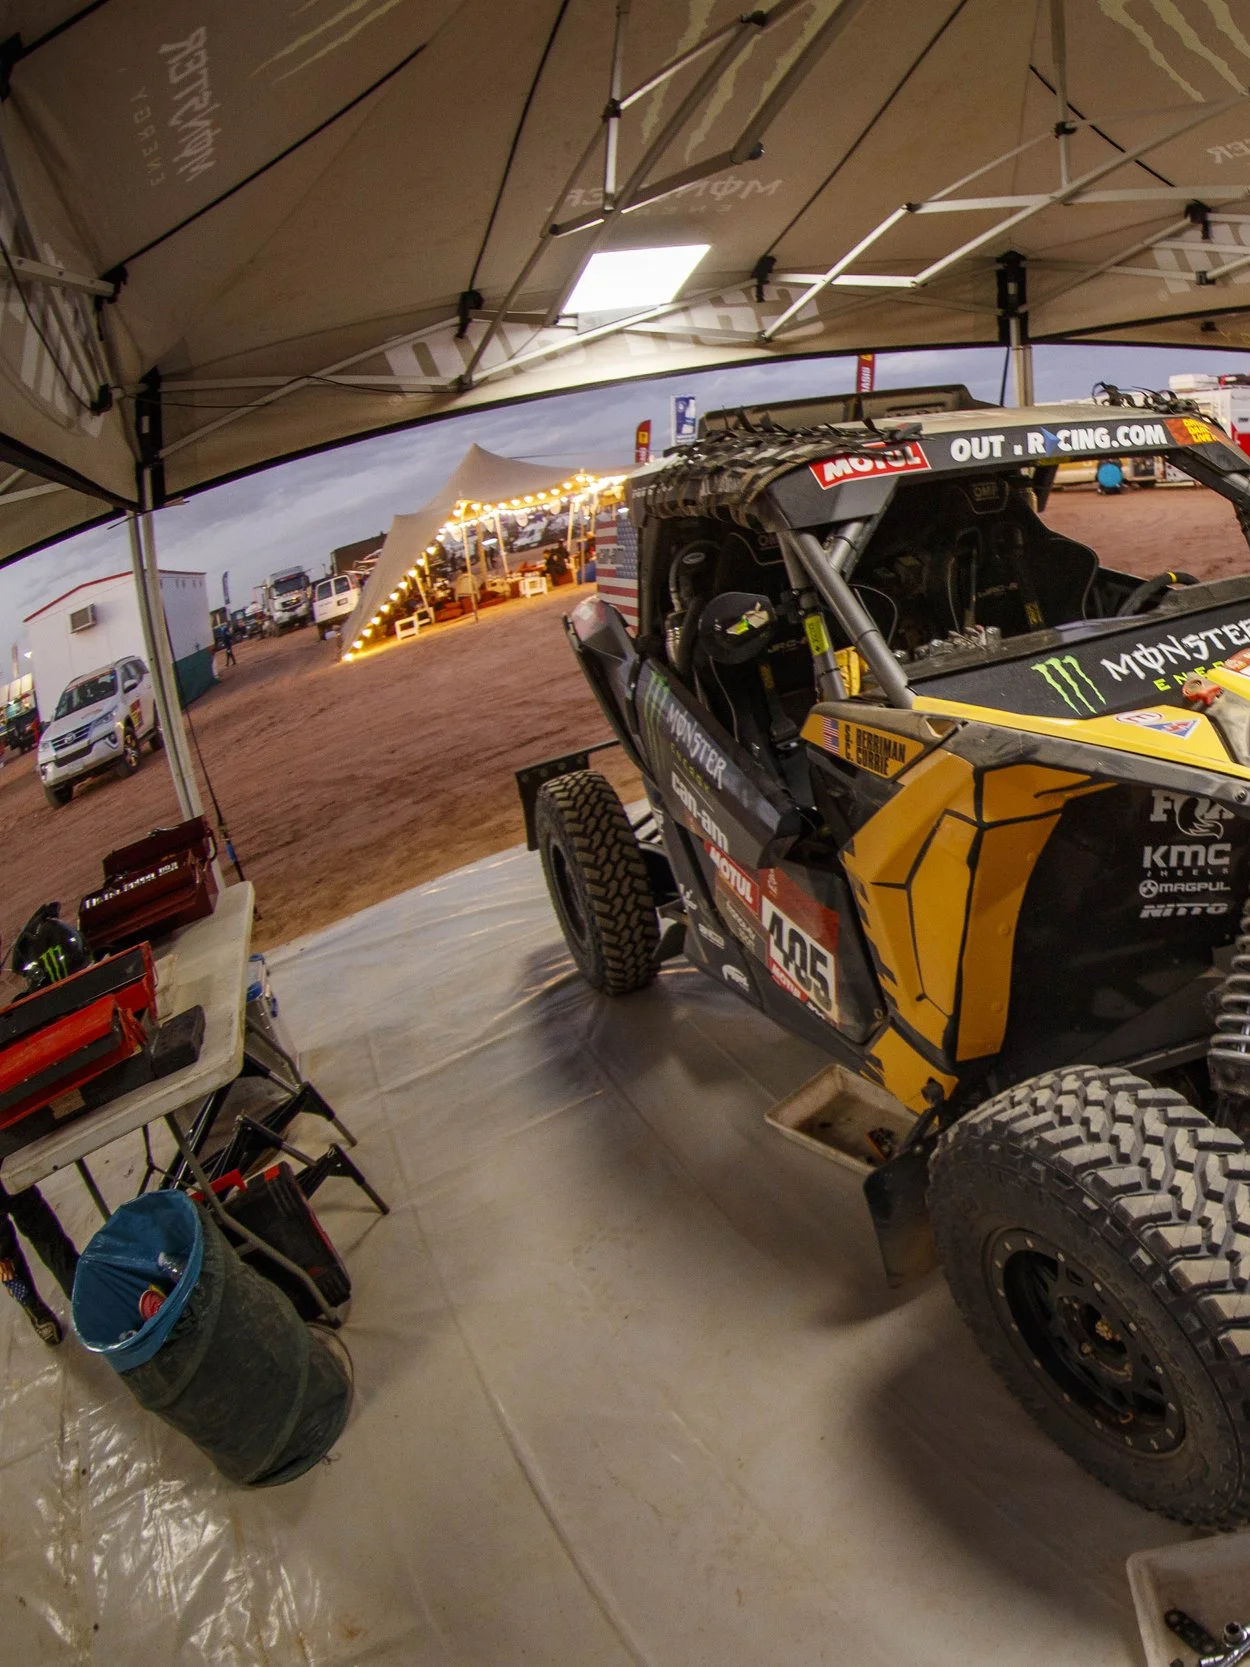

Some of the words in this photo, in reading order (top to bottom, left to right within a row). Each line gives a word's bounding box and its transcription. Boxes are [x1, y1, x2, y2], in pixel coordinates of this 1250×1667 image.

[950, 435, 1004, 463] OUT
[661, 703, 727, 790] MONSTER
[1150, 789, 1235, 841] FOX
[709, 846, 753, 905] MOTUL
[1142, 843, 1232, 868] KMC
[1159, 881, 1232, 893] MAGPUL
[1139, 902, 1229, 919] NITTO
[770, 910, 832, 1012] 405
